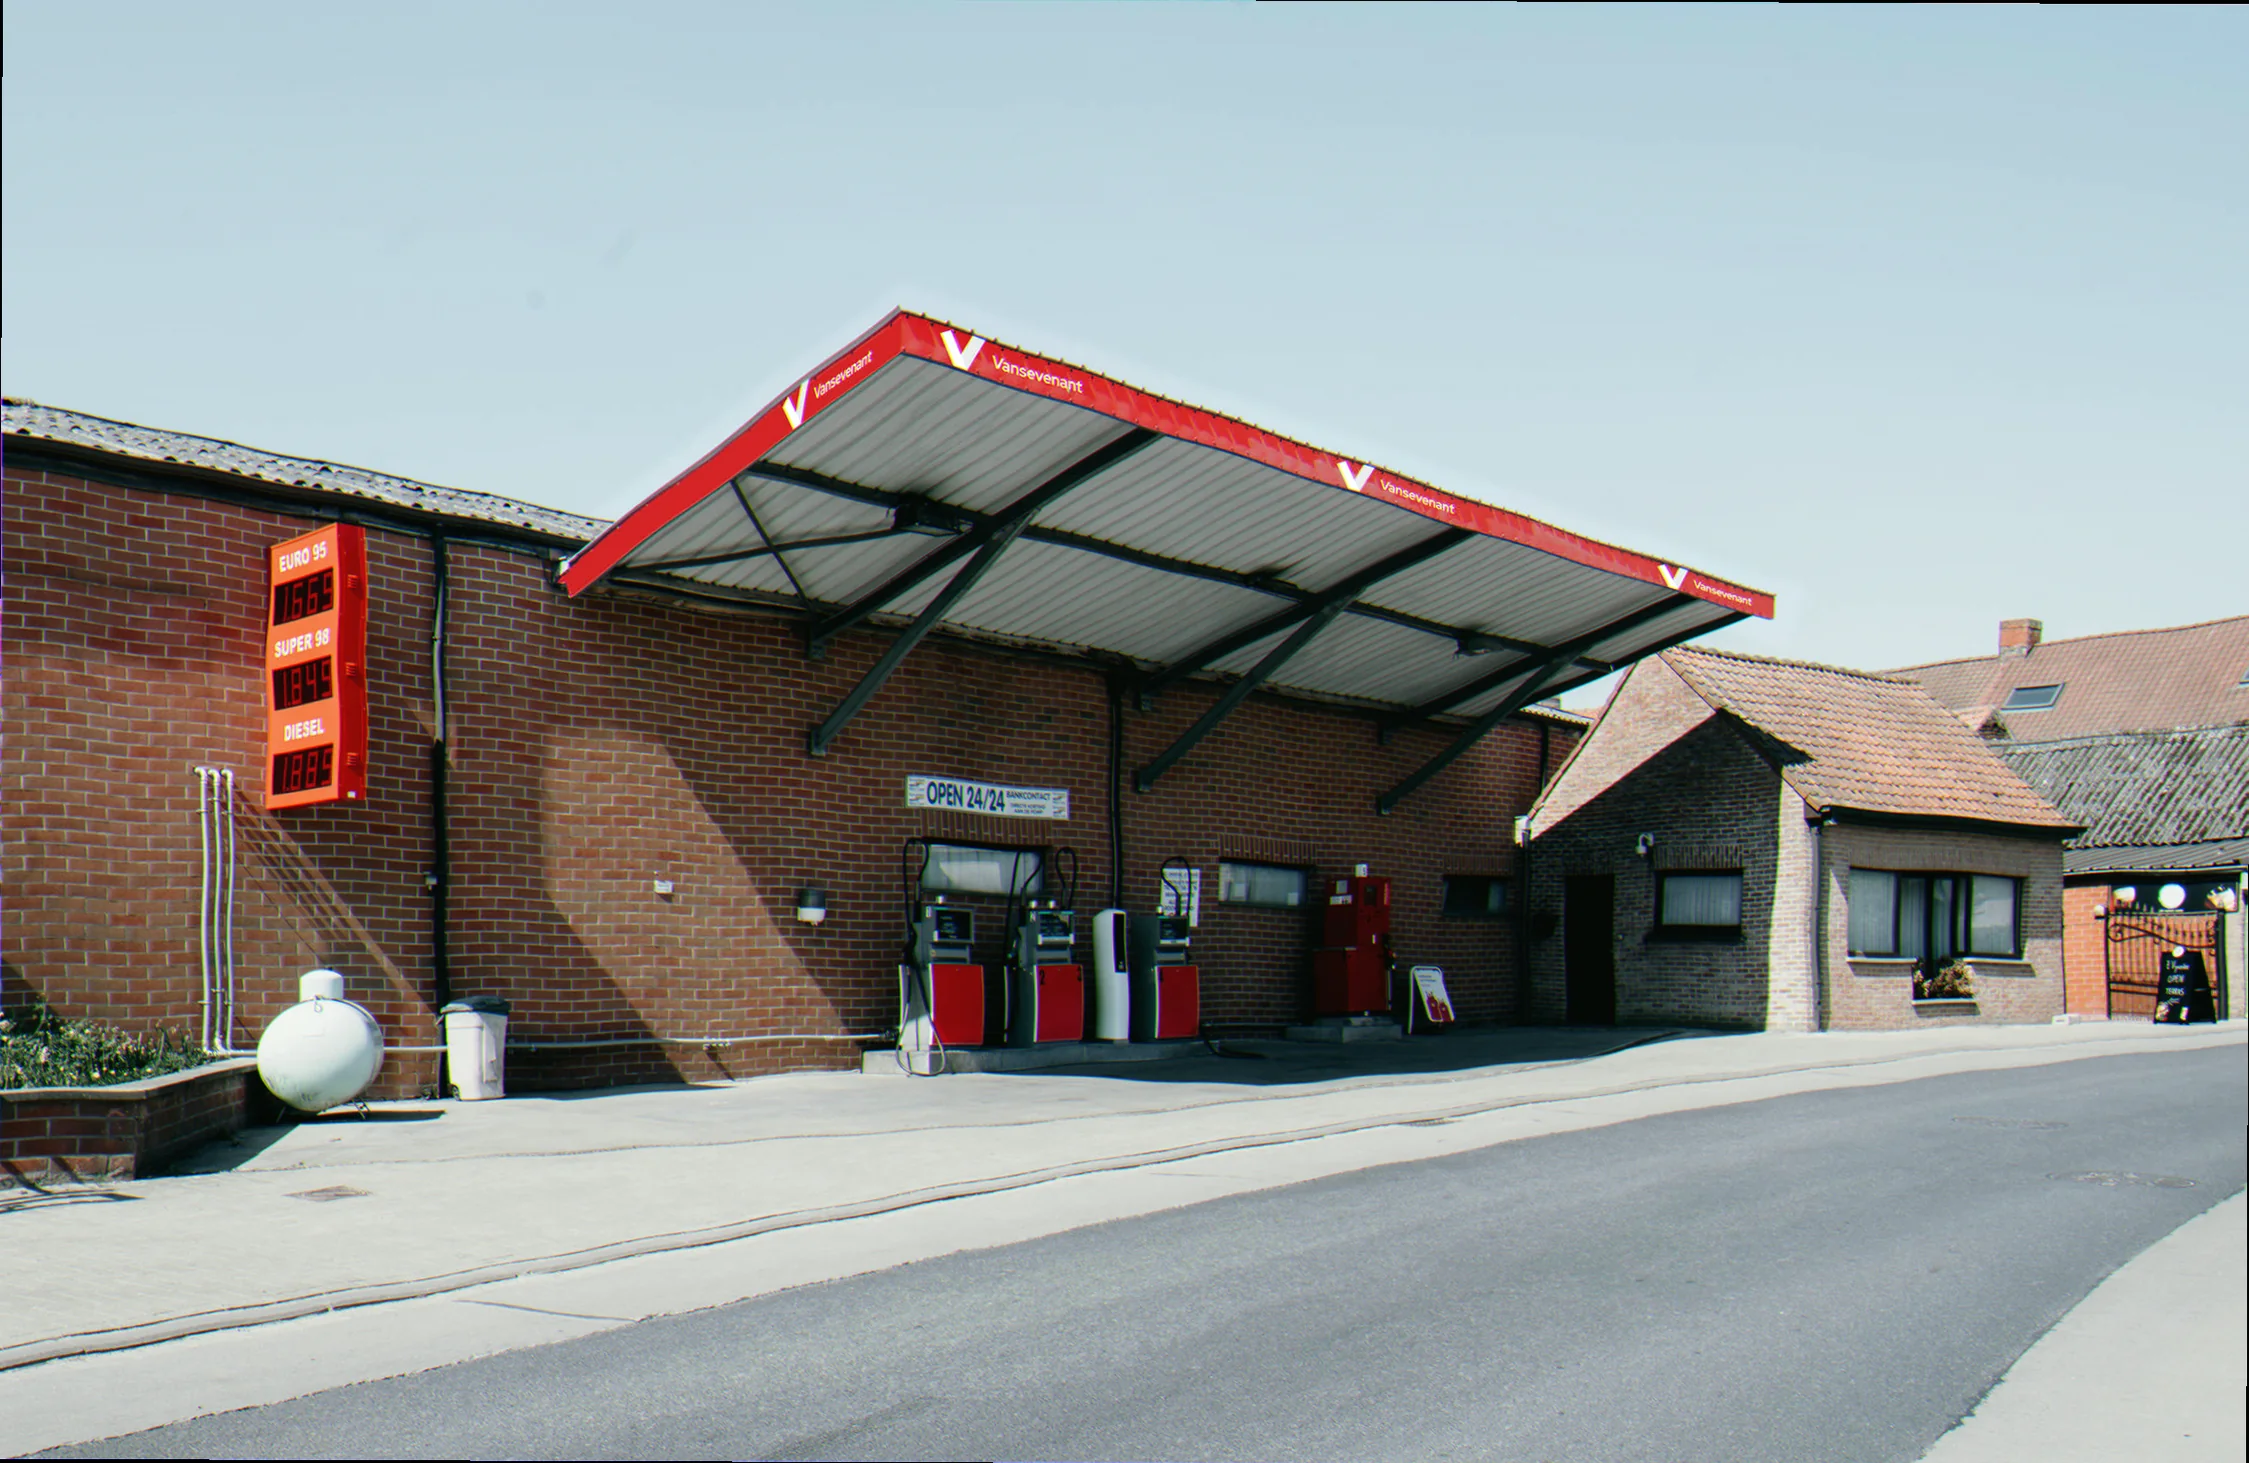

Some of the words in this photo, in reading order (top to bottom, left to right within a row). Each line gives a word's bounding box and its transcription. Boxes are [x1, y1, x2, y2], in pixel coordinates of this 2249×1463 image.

[813, 350, 873, 399] Vansevenant
[991, 354, 1084, 394] Vansevenant
[1380, 479, 1455, 514] Vansevenant
[279, 547, 310, 573] EURO
[312, 541, 327, 560] 95
[1693, 579, 1753, 606] Vansevenant
[274, 632, 312, 658] SUPER
[315, 628, 330, 648] 98
[284, 718, 325, 742] DIESEL
[927, 781, 964, 807] OPEN
[966, 786, 1005, 812] 24/24
